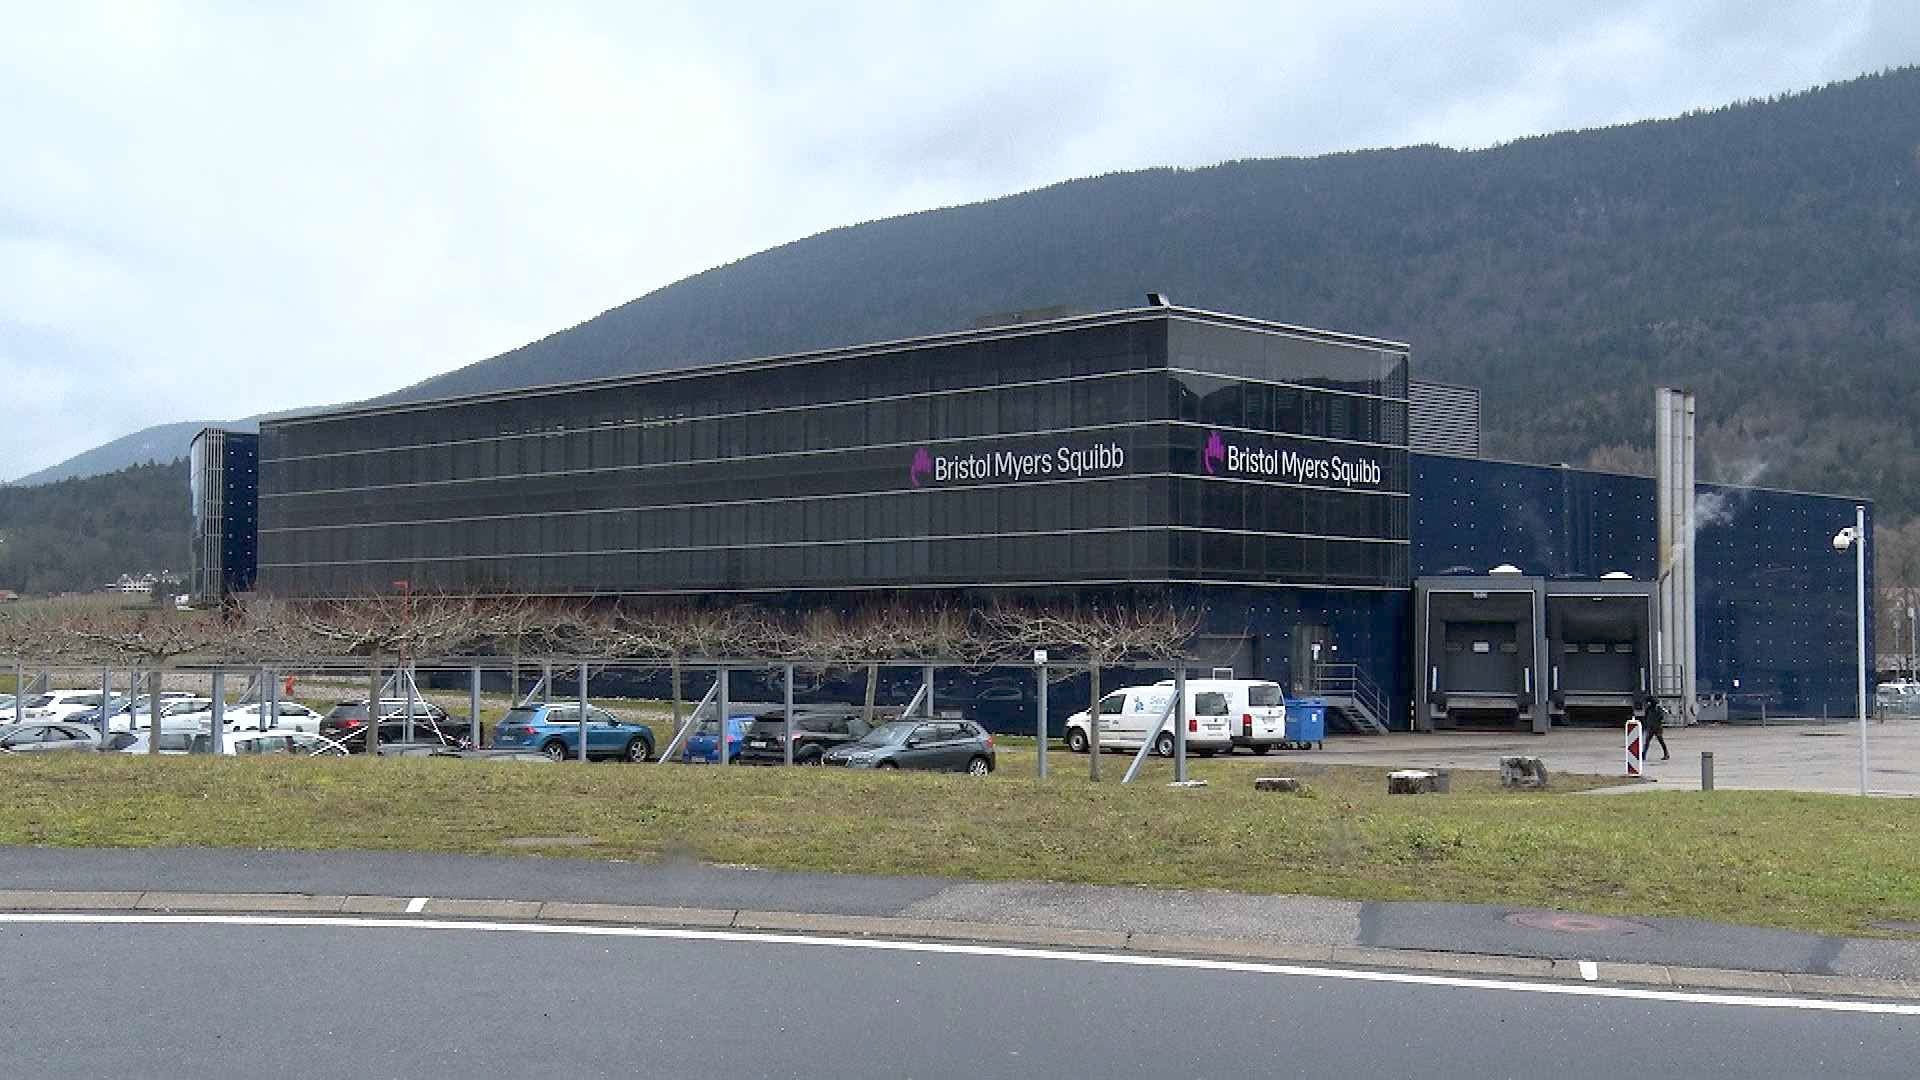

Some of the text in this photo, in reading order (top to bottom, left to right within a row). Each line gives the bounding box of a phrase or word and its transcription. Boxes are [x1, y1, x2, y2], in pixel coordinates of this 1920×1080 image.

[935, 442, 1124, 481] Bristol Myers Squibb
[1228, 445, 1381, 487] Bristol Myers Squibb
